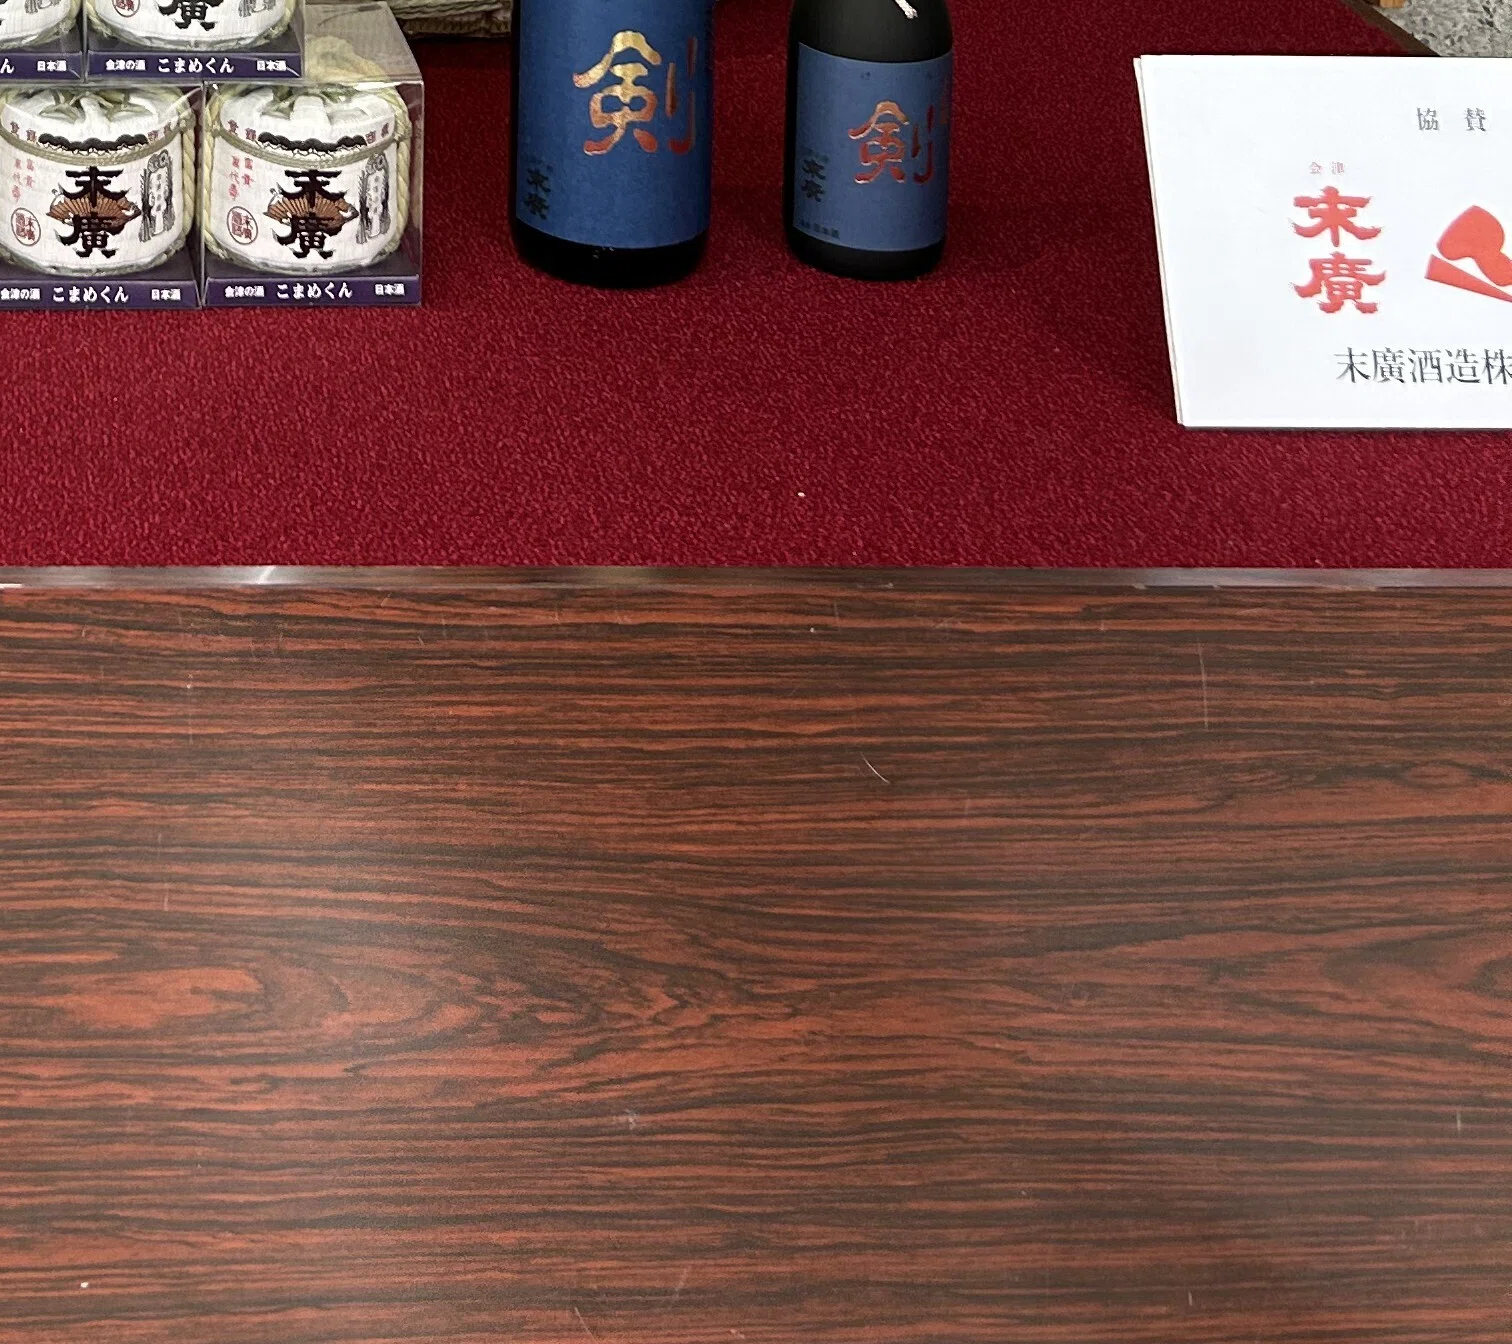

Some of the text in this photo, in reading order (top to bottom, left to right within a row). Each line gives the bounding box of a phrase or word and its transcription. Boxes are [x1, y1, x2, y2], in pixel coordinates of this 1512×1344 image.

[158, 57, 234, 74] こまめくん
[1416, 107, 1488, 131] 協賛
[1288, 185, 1386, 314] 末廣
[52, 285, 129, 304] こまめくん
[276, 281, 353, 300] こまめくん
[1335, 346, 1512, 386] 末廣酒造株
